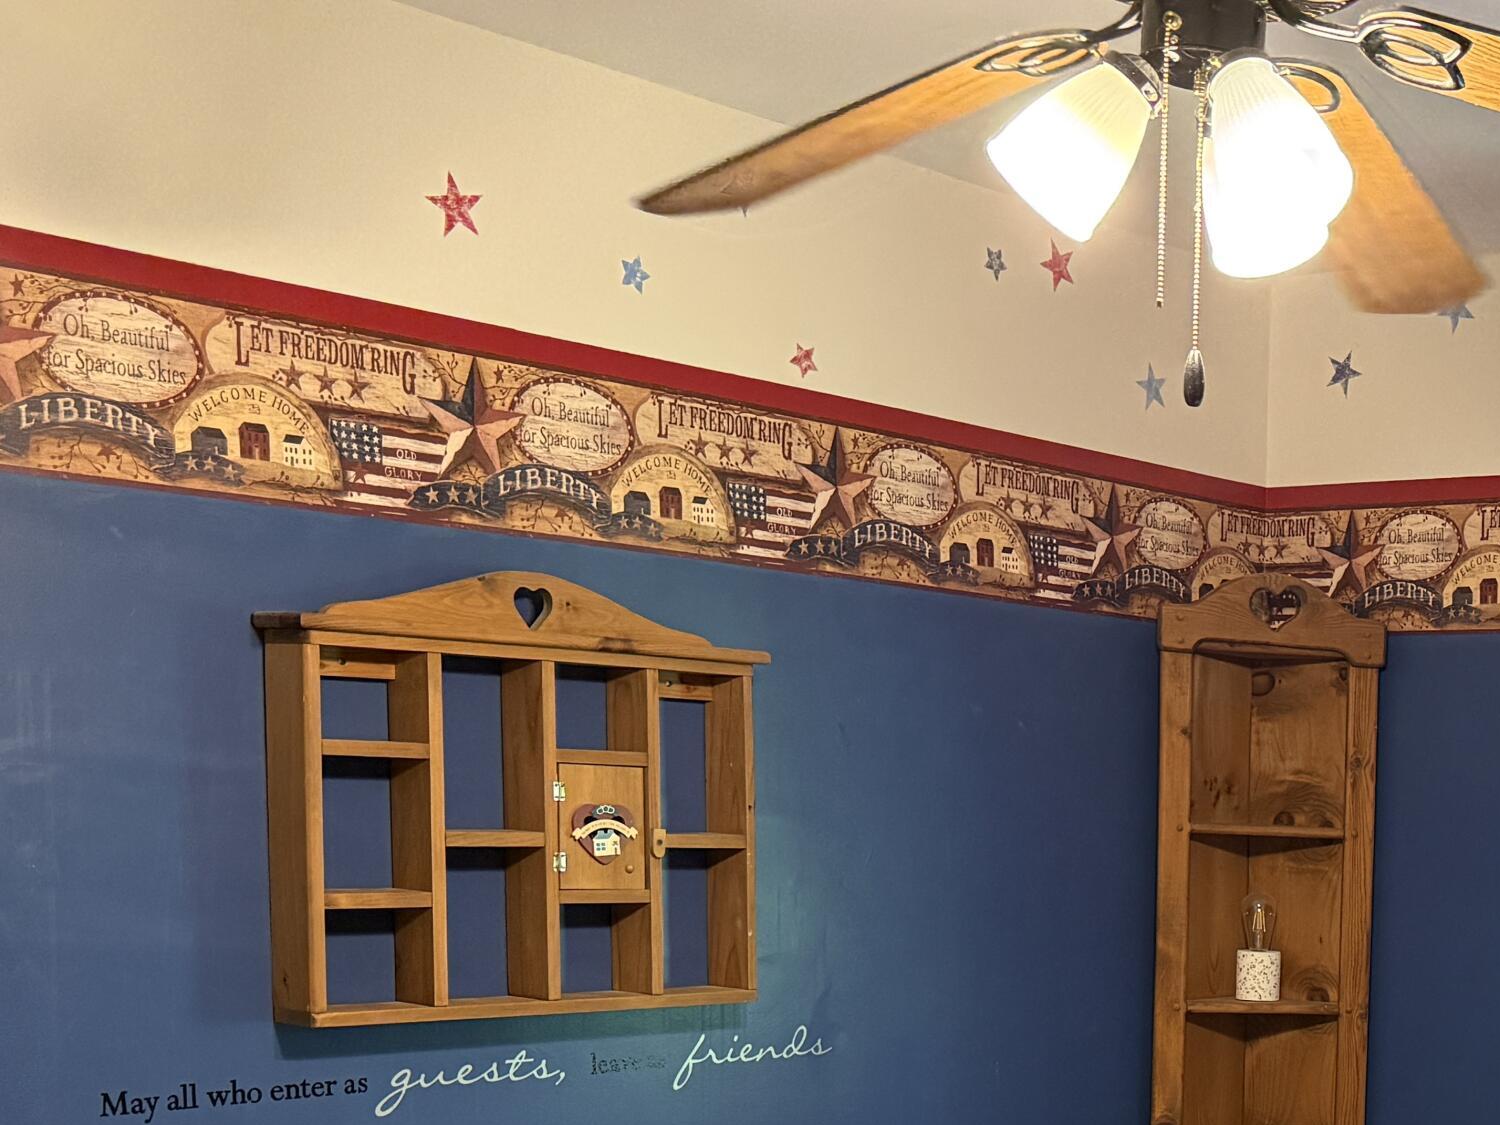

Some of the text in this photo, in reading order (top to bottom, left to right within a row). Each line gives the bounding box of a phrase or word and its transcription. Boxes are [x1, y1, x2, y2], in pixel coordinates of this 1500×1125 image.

[63, 313, 171, 352] Oh, Beautiful
[48, 345, 187, 386] for Spacious Skies
[234, 321, 417, 396] LET FREEDOM RING
[17, 397, 162, 448] LIBERTY
[187, 387, 310, 435] WELCOME HOME
[531, 397, 610, 428] Oh, Beautiful
[539, 426, 590, 452] Spacious
[593, 434, 622, 456] Skies
[656, 399, 793, 461] LET FREEDOM RING
[396, 449, 417, 461] OLD
[384, 466, 423, 482] GLORY
[498, 468, 601, 510] LIBERTY
[621, 456, 714, 496] WELCOME HOME
[880, 460, 940, 488] Oh, Beautiful
[975, 462, 1080, 514] LET FREEDOM RING
[776, 507, 793, 518] OLD
[886, 487, 924, 511] Spacious
[926, 493, 949, 513] Skies
[767, 523, 797, 535] GLORY
[948, 511, 994, 539] WELCOME
[1240, 515, 1288, 539] FREEDOM
[1287, 517, 1315, 548] RING
[1388, 526, 1444, 545] Oh, Beautiful
[854, 523, 933, 559] LIBERTY
[1393, 550, 1429, 567] Spacious
[1430, 547, 1453, 563] Skies
[1451, 553, 1498, 585] WELCOME
[1125, 568, 1186, 598] LIBERTY
[1364, 581, 1436, 610] LIBERTY
[100, 1090, 160, 1124] May
[166, 1083, 199, 1111] all
[206, 1079, 263, 1108] who
[270, 1078, 338, 1102] enter
[343, 1077, 369, 1095] as
[374, 1049, 566, 1118] guests,
[672, 1024, 833, 1091] friends
